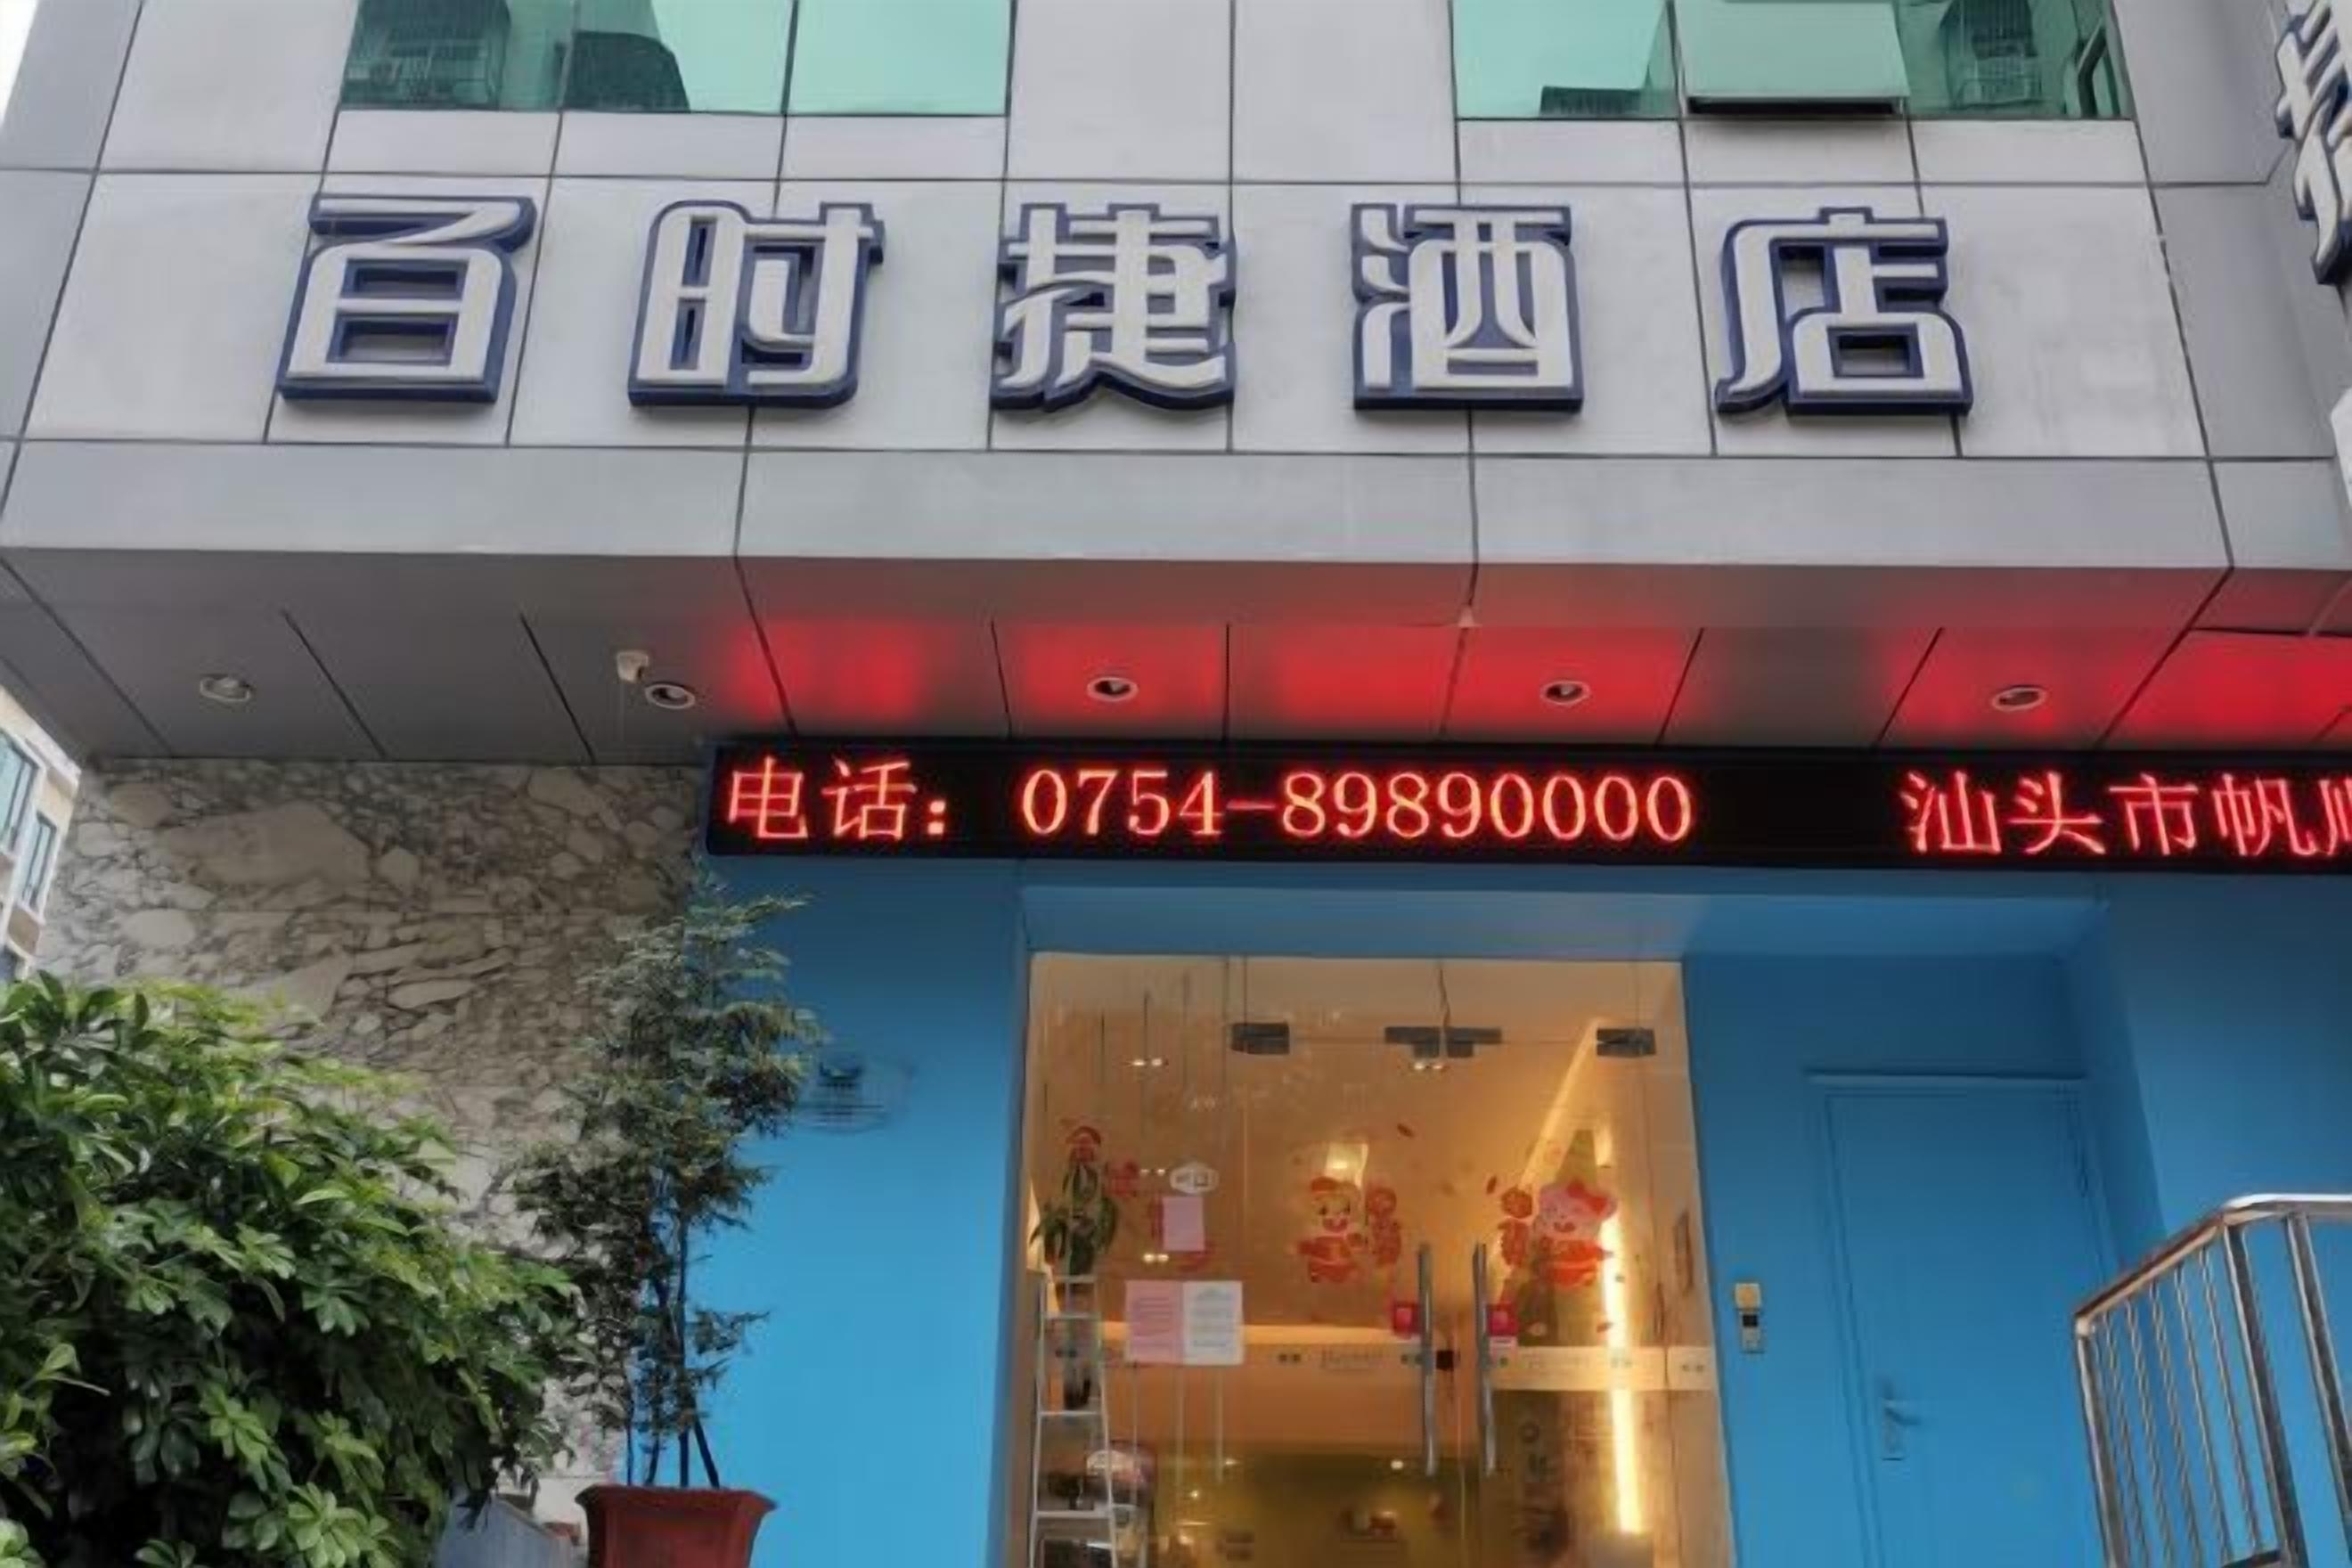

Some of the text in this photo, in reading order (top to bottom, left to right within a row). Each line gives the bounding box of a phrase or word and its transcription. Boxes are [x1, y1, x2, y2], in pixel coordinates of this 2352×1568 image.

[278, 193, 1971, 414] 百时捷酒店
[1020, 767, 1694, 843] 0754-89890000
